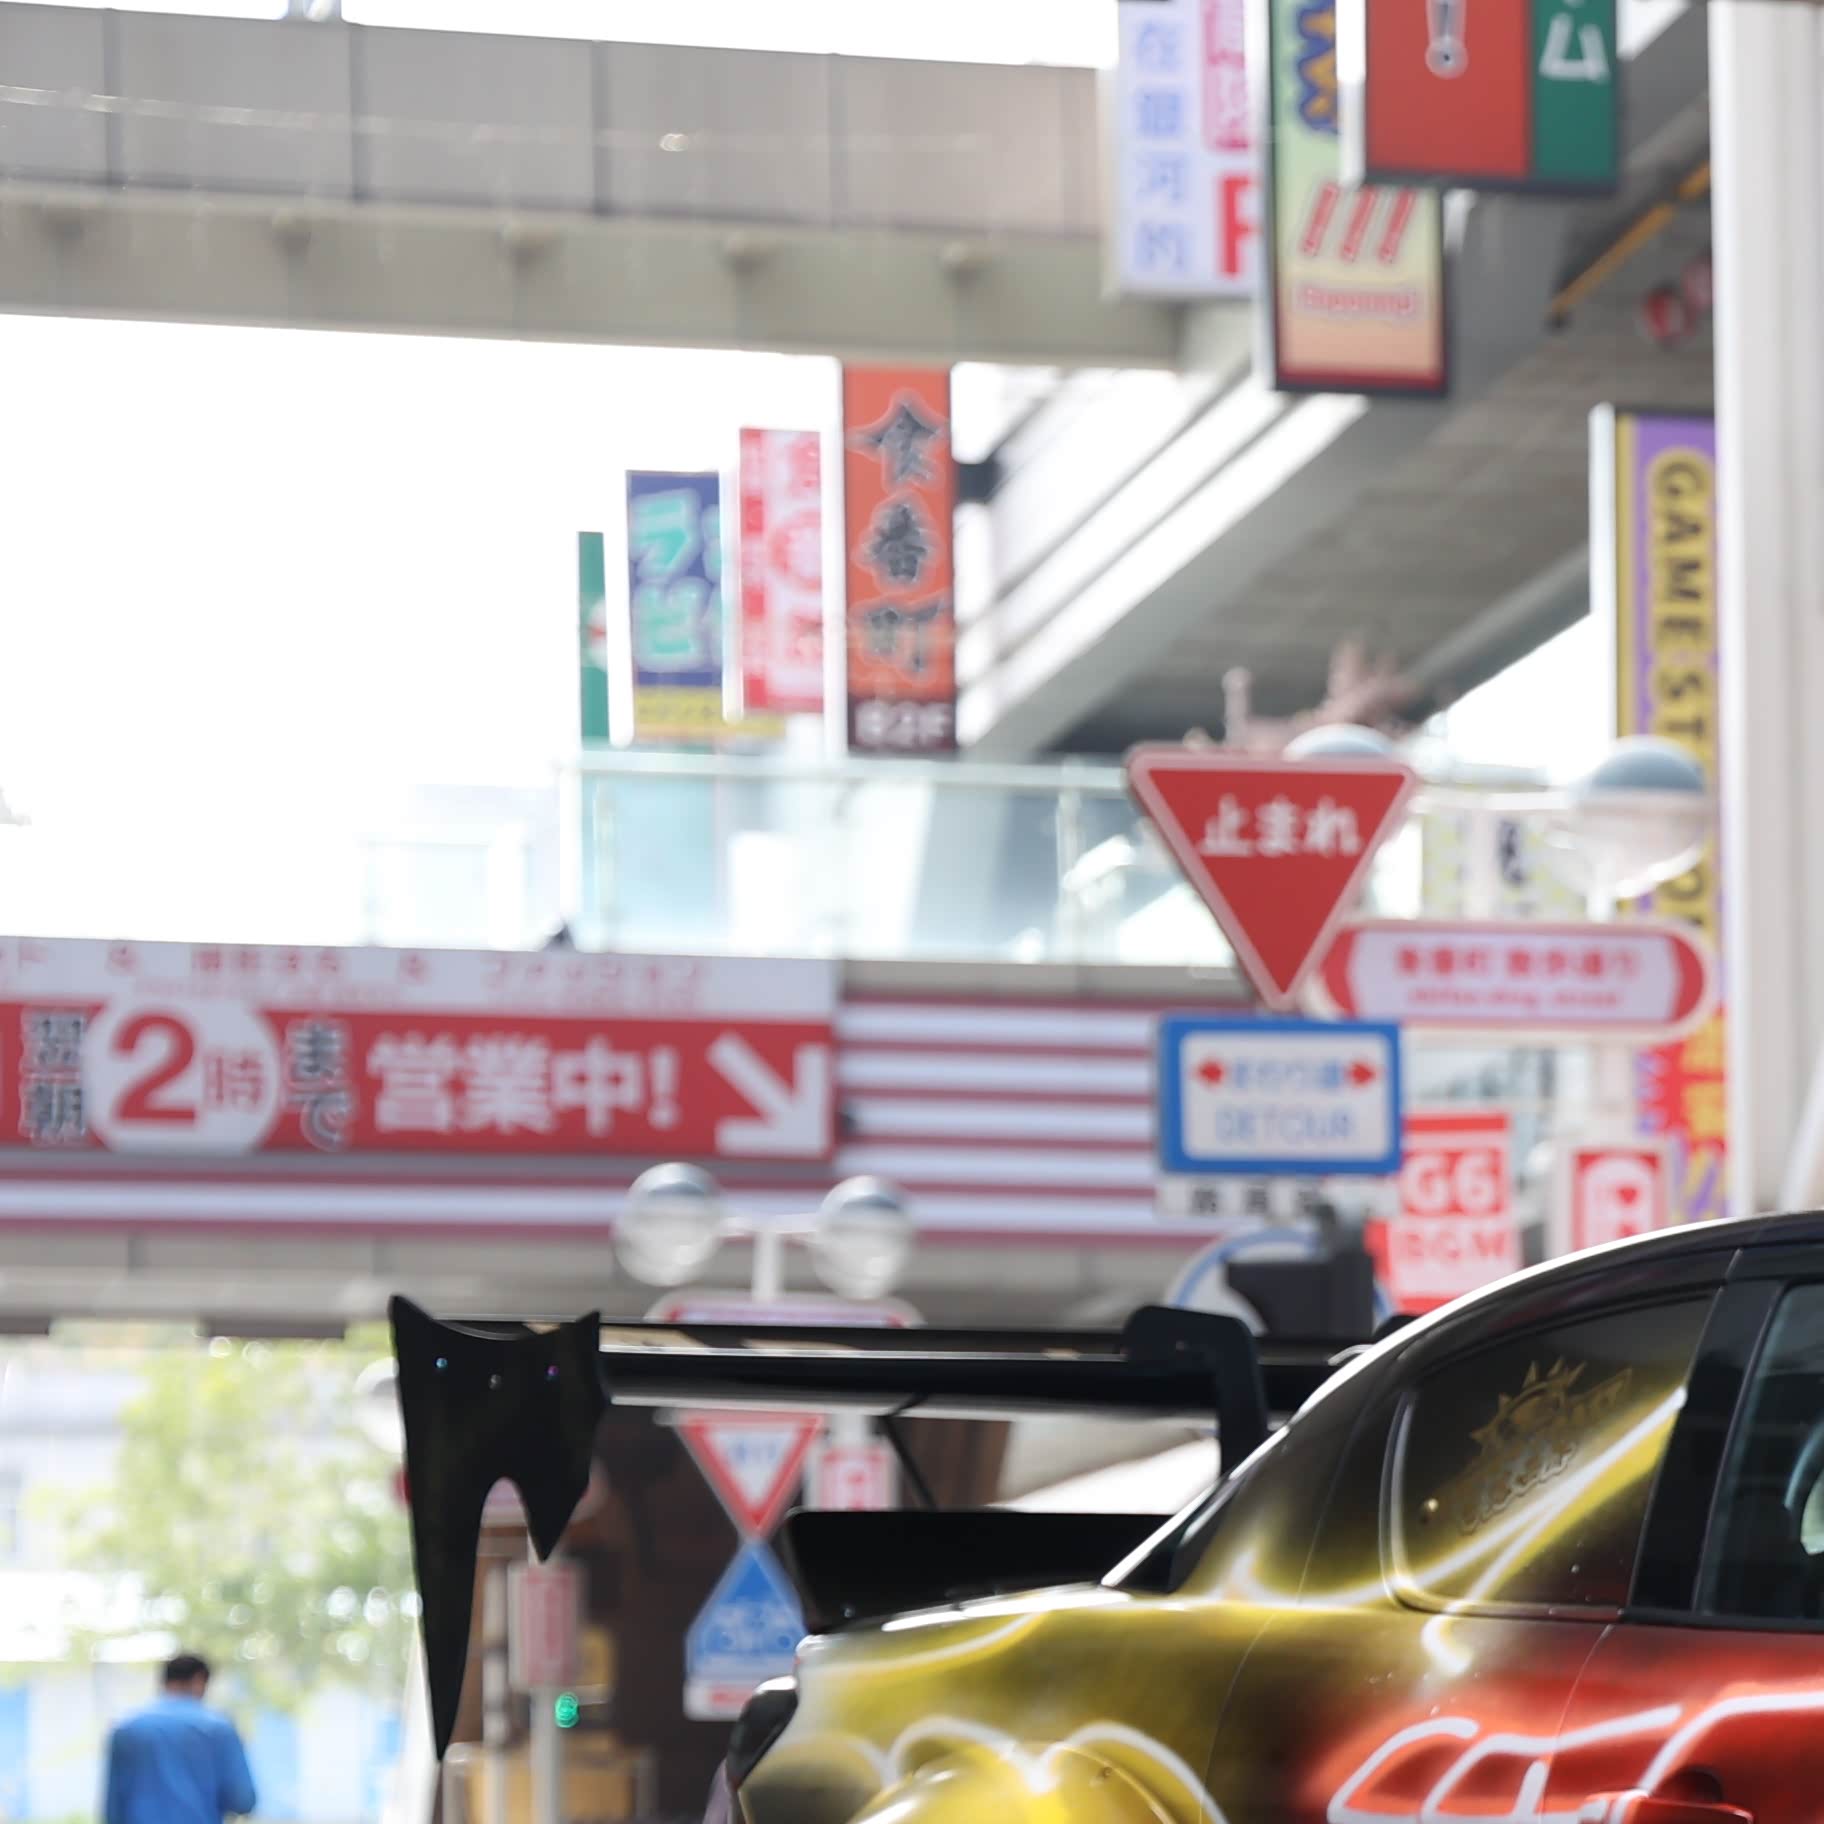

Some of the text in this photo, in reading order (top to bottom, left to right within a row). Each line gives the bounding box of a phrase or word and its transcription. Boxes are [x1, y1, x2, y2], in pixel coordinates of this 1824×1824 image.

[1199, 793, 1363, 859] 止まれ
[1215, 1105, 1357, 1143] DETOUR
